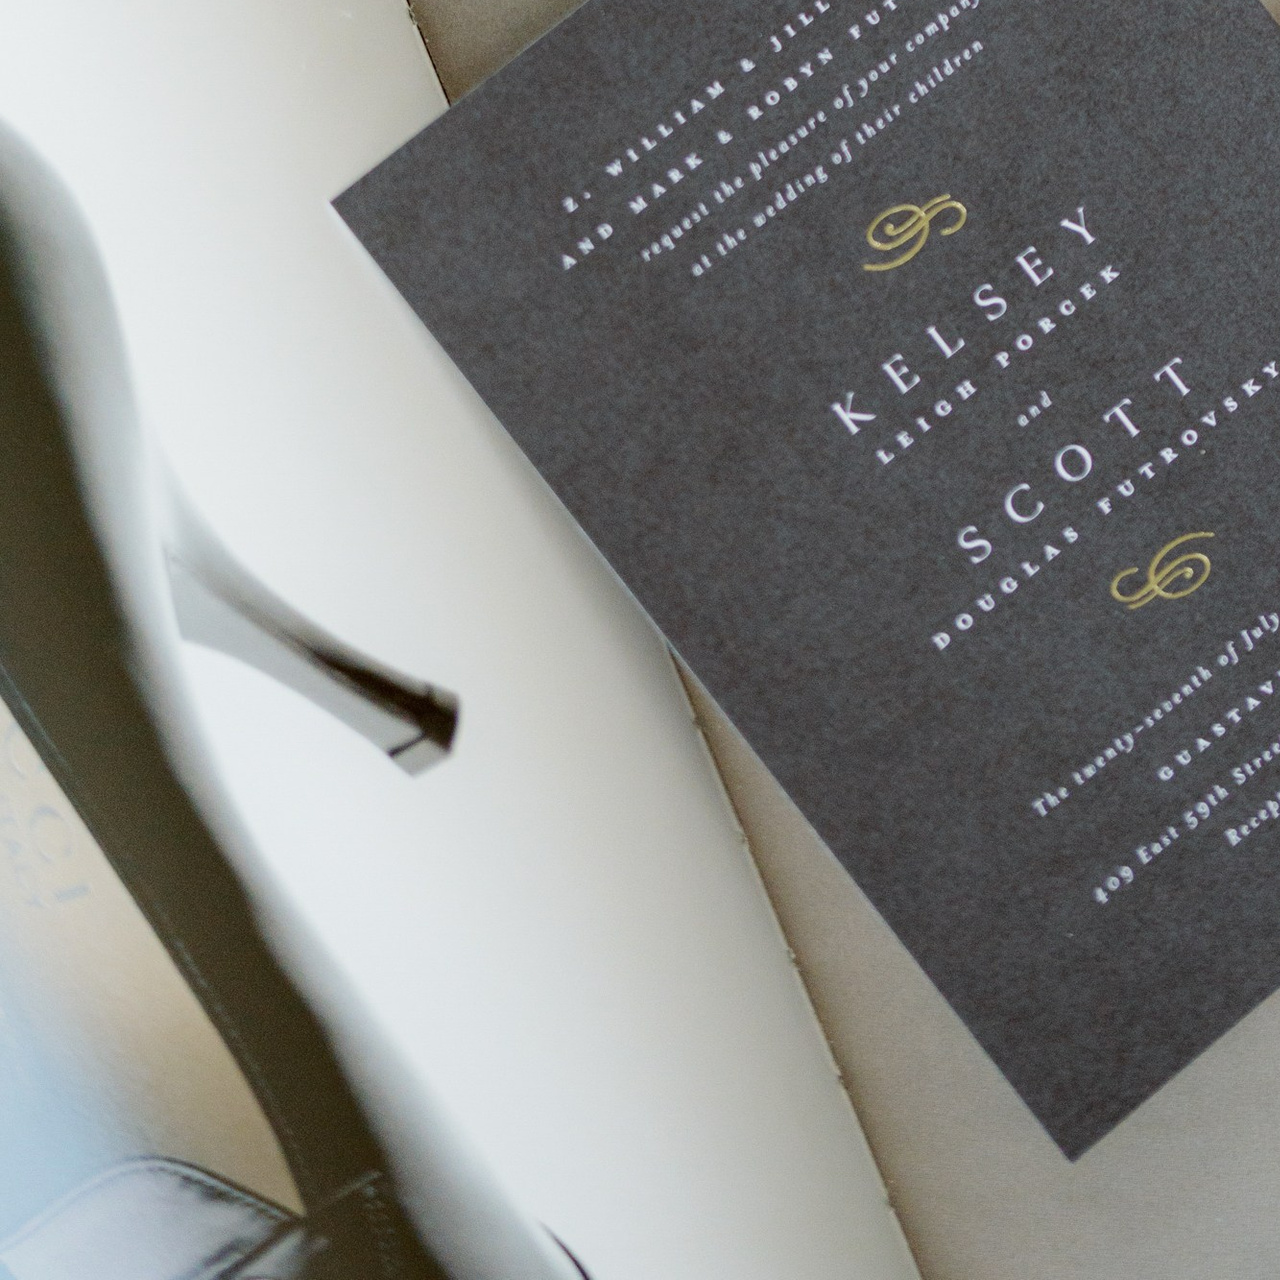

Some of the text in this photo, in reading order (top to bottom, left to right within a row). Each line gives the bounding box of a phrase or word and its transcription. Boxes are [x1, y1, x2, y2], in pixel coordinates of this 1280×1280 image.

[562, 223, 614, 270] AND
[629, 153, 703, 214] MARK
[717, 130, 733, 145] &
[747, 48, 833, 121] ROBYN
[606, 81, 725, 177] WILLIAM
[740, 58, 756, 73] &
[770, 0, 831, 53] JILL
[642, 202, 709, 262] request
[713, 176, 745, 204] the
[749, 110, 827, 181] pleasure
[833, 84, 854, 110] of
[858, 52, 898, 98] your
[692, 40, 984, 277] at the wedding of their children
[831, 206, 1096, 435] KELSEY
[876, 265, 1120, 465] LEIGH PORCEK
[1017, 390, 1053, 427] and
[932, 361, 1279, 651] DOUGLAS FUTROVSKY
[957, 357, 1191, 564] SCOTT
[1031, 786, 1069, 817] The
[1072, 666, 1213, 785] twenty-seventh
[1217, 640, 1239, 667] of
[1095, 865, 1134, 904] 409
[1136, 826, 1179, 865] East
[1183, 784, 1229, 830] 59th
